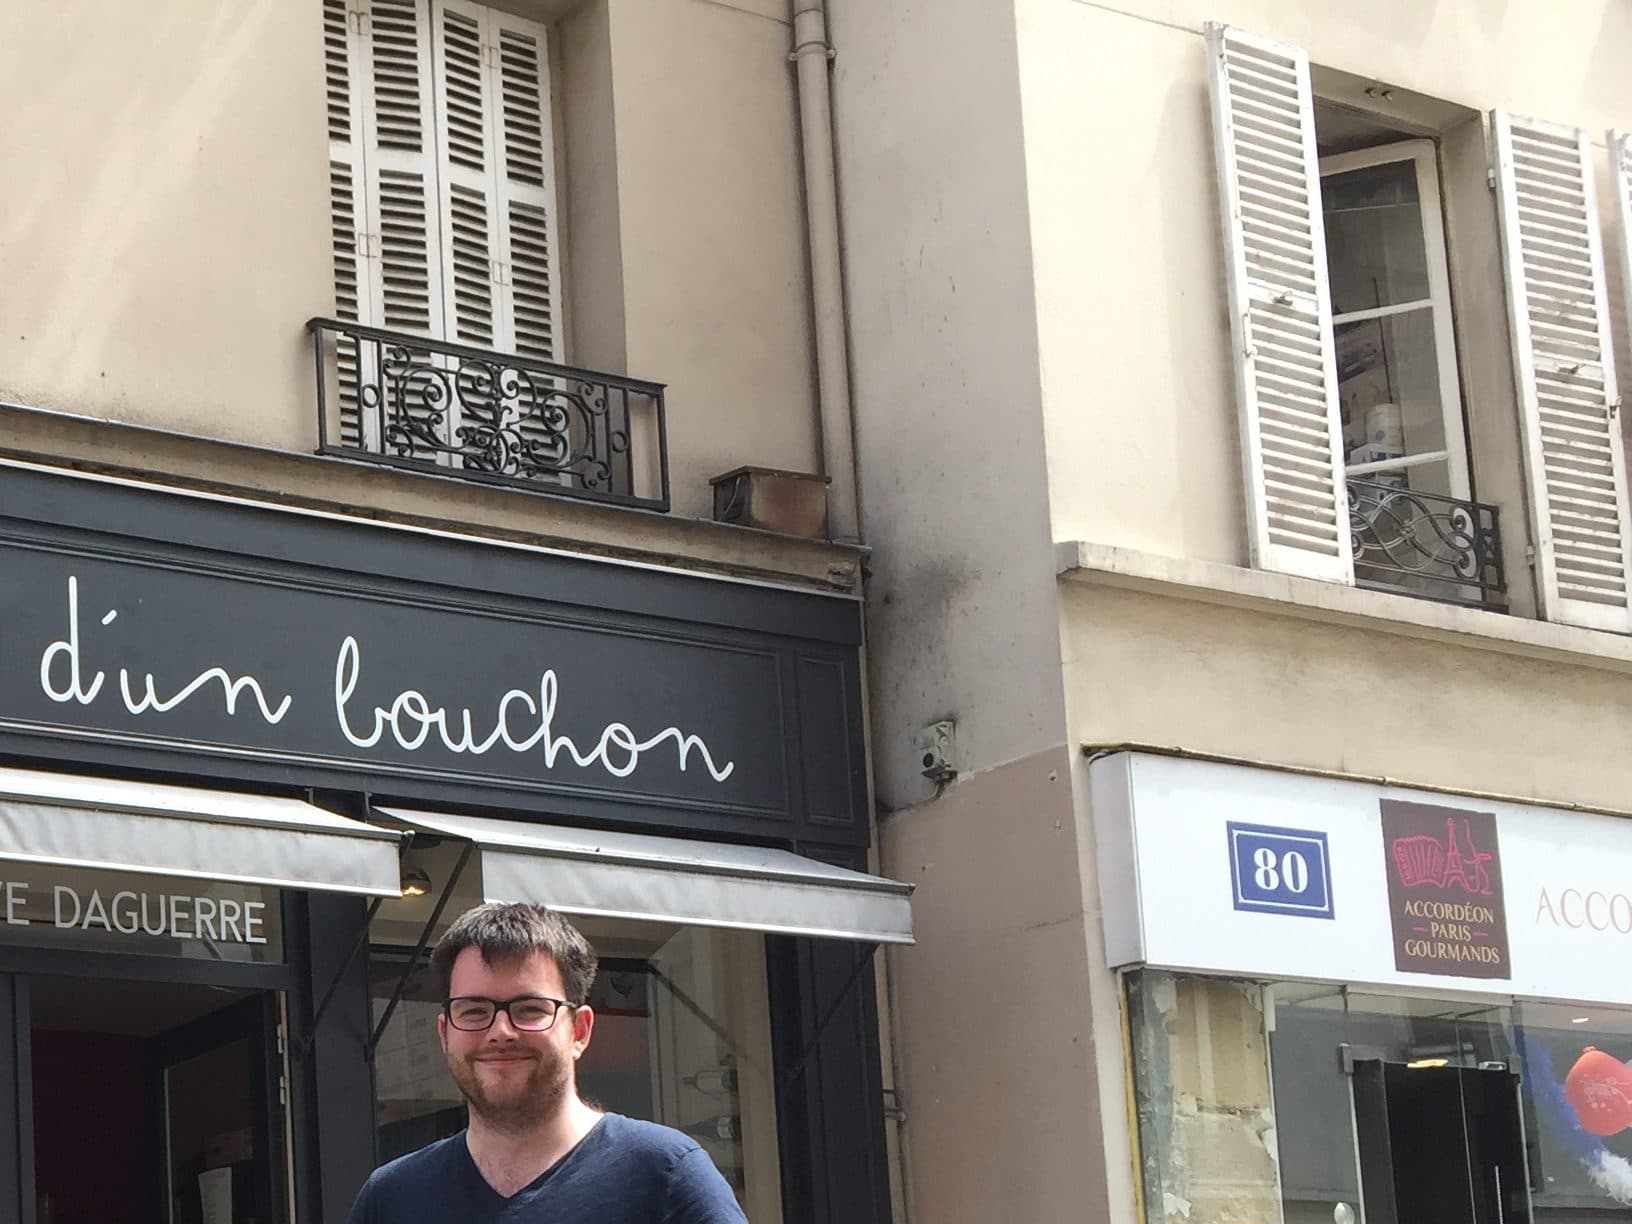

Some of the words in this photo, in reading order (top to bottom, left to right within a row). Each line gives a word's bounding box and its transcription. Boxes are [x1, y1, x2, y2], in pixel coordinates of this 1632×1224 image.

[40, 576, 292, 725] d'un
[335, 636, 735, 782] bouchon
[1254, 847, 1309, 894] 80
[54, 885, 268, 944] DAGUERRE
[1404, 900, 1494, 924] ACCORDÉON
[1431, 921, 1471, 942] PARIS
[1405, 939, 1500, 964] GOURMANDS
